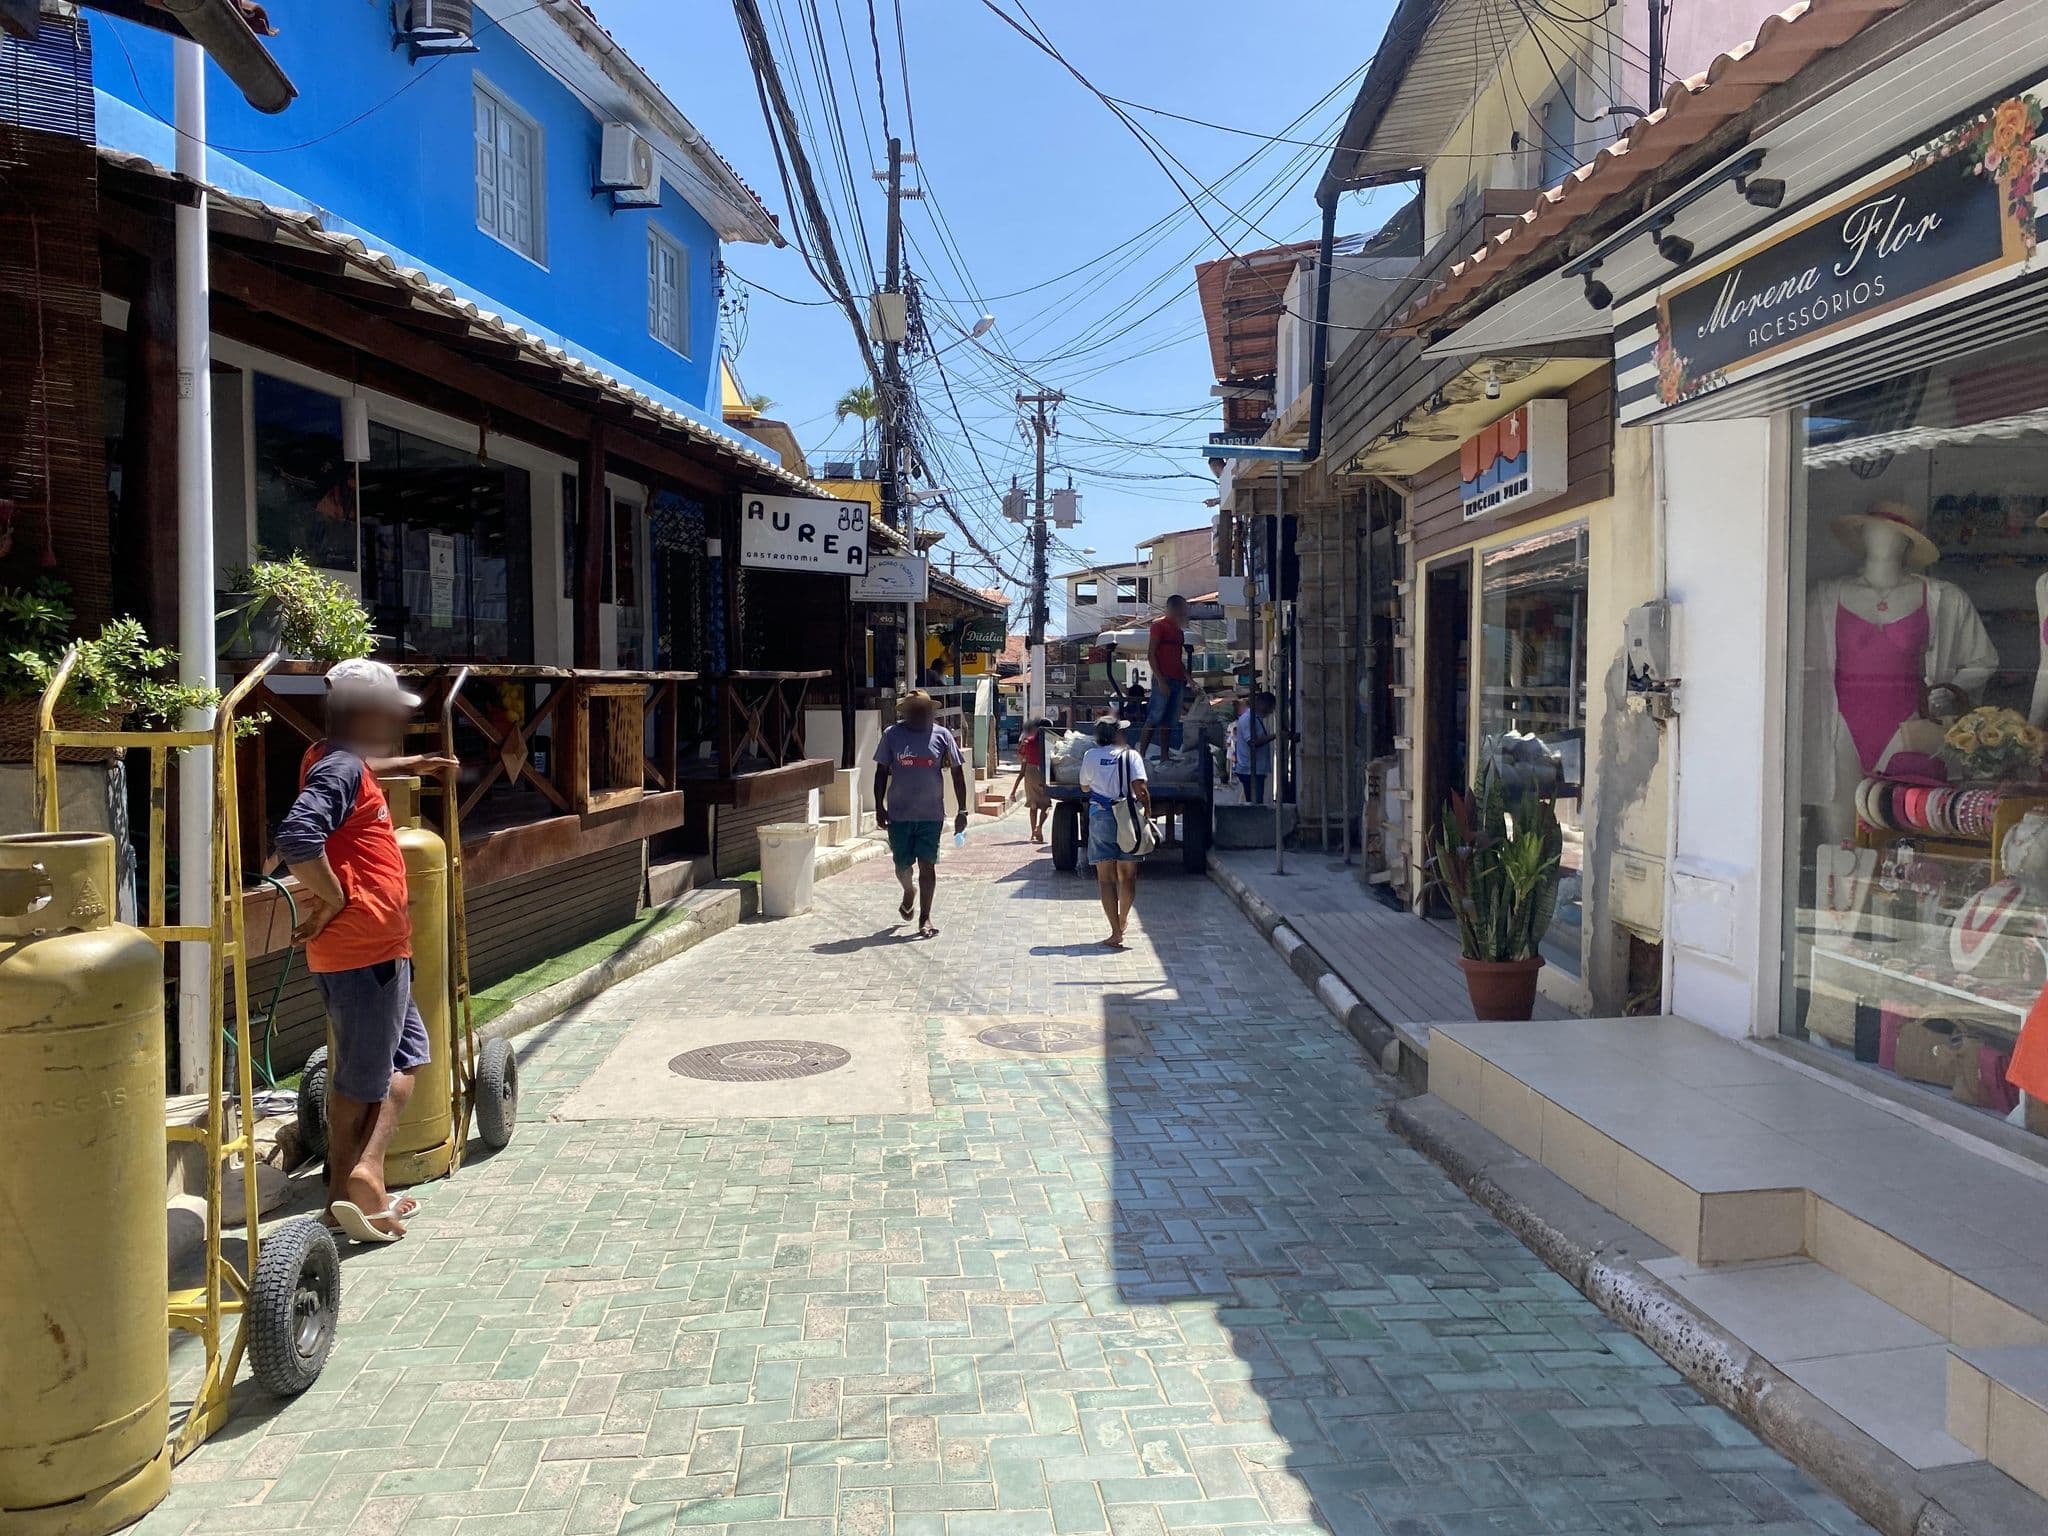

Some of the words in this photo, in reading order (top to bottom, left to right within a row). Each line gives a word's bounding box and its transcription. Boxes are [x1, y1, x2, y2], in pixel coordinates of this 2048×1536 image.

[1697, 269, 1821, 338] Morena
[1834, 193, 1942, 277] Flor
[1749, 275, 1886, 348] ACESSÓRIOS
[748, 501, 862, 565] AUREA
